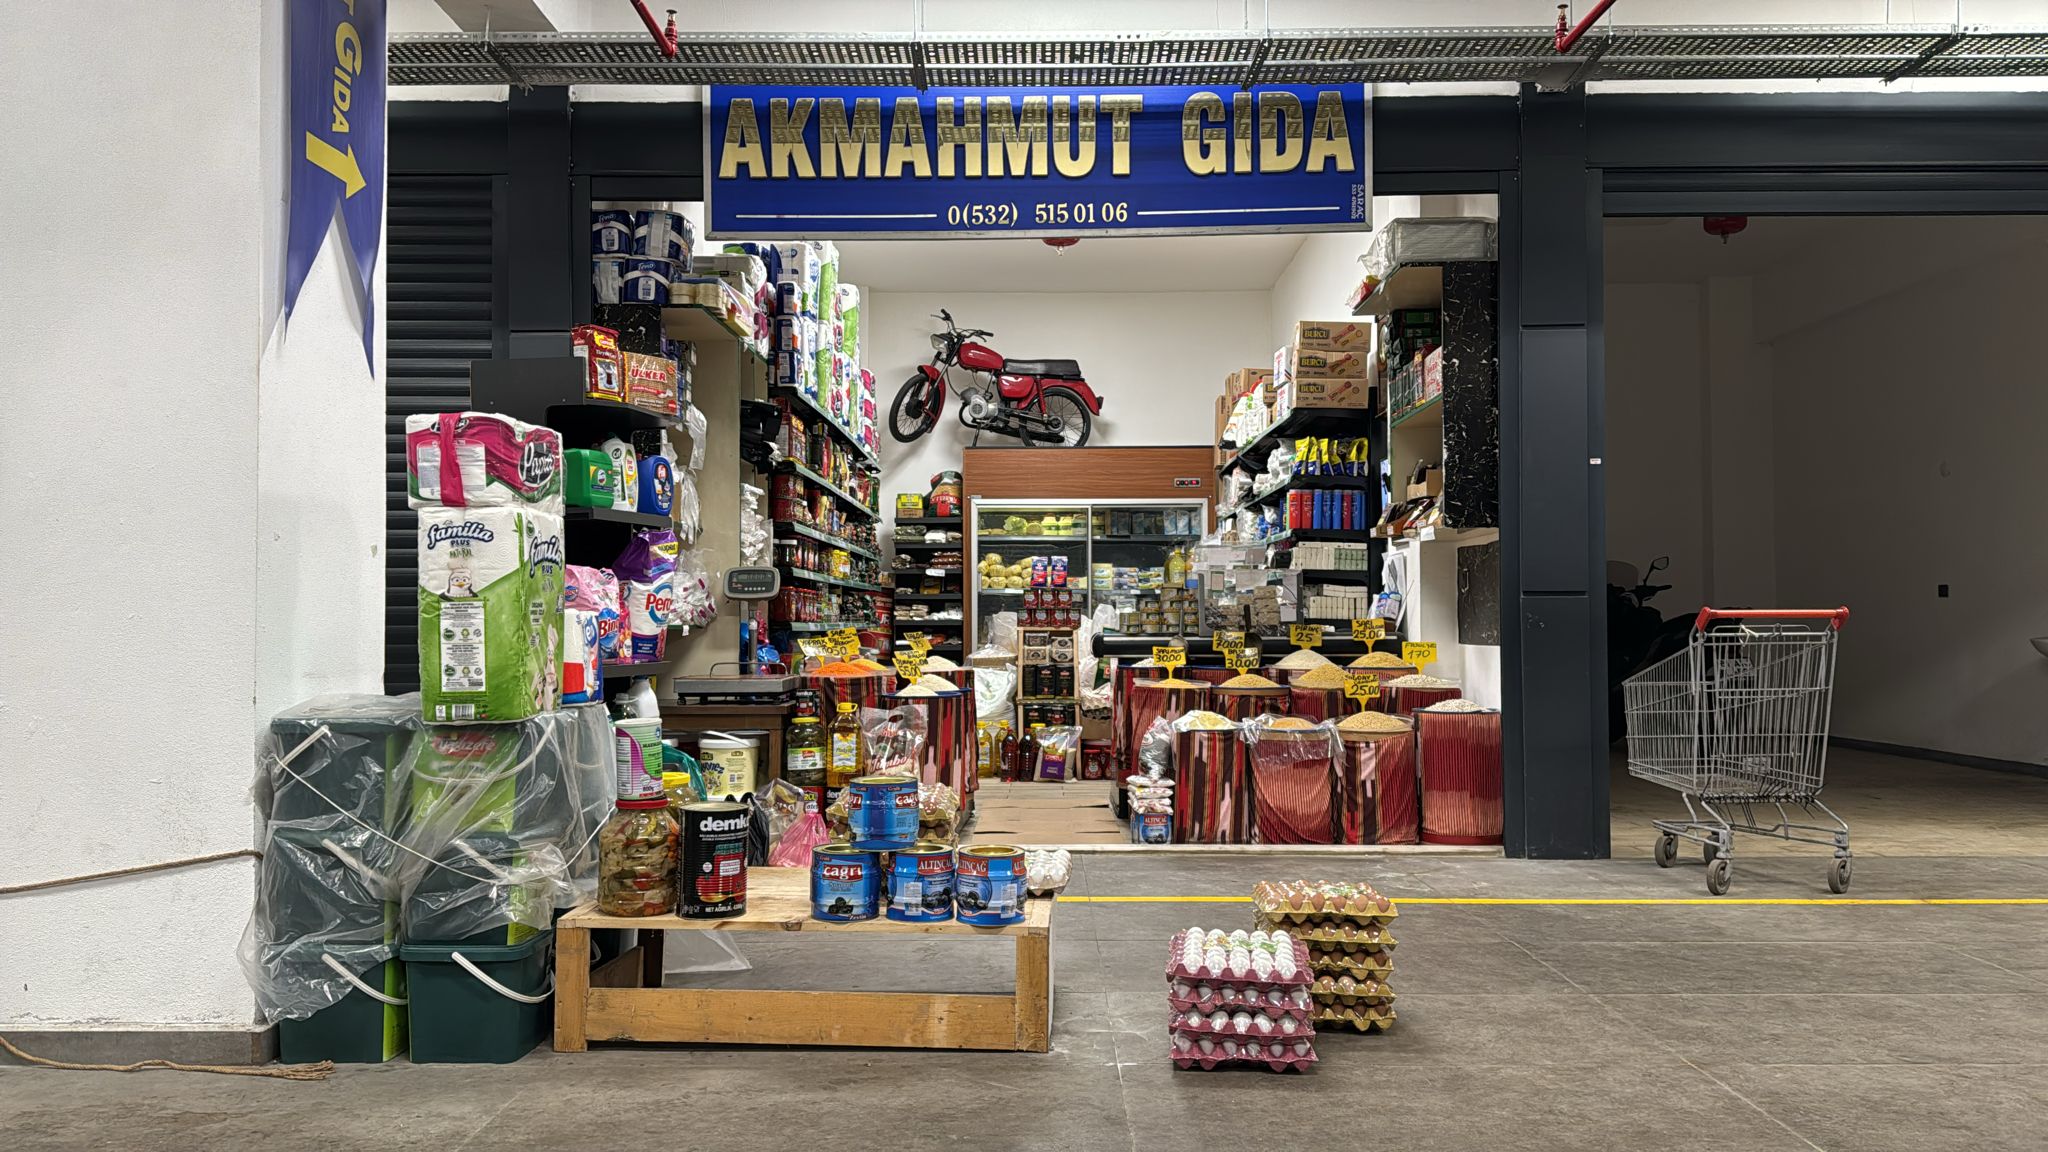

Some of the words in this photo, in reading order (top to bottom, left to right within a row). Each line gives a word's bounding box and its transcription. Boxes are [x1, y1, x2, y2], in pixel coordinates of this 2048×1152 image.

[332, 21, 363, 133] GIDA
[718, 93, 1144, 179] AKMAHMUT
[1182, 91, 1356, 175] GIDA
[947, 202, 1018, 228] 0(532)
[1035, 203, 1069, 225] 515
[1074, 203, 1095, 224] 01
[1101, 202, 1128, 223] 06
[631, 363, 667, 382] ÜLKER
[427, 521, 494, 550] familia
[599, 619, 619, 638] Bin
[1296, 633, 1313, 642] 25
